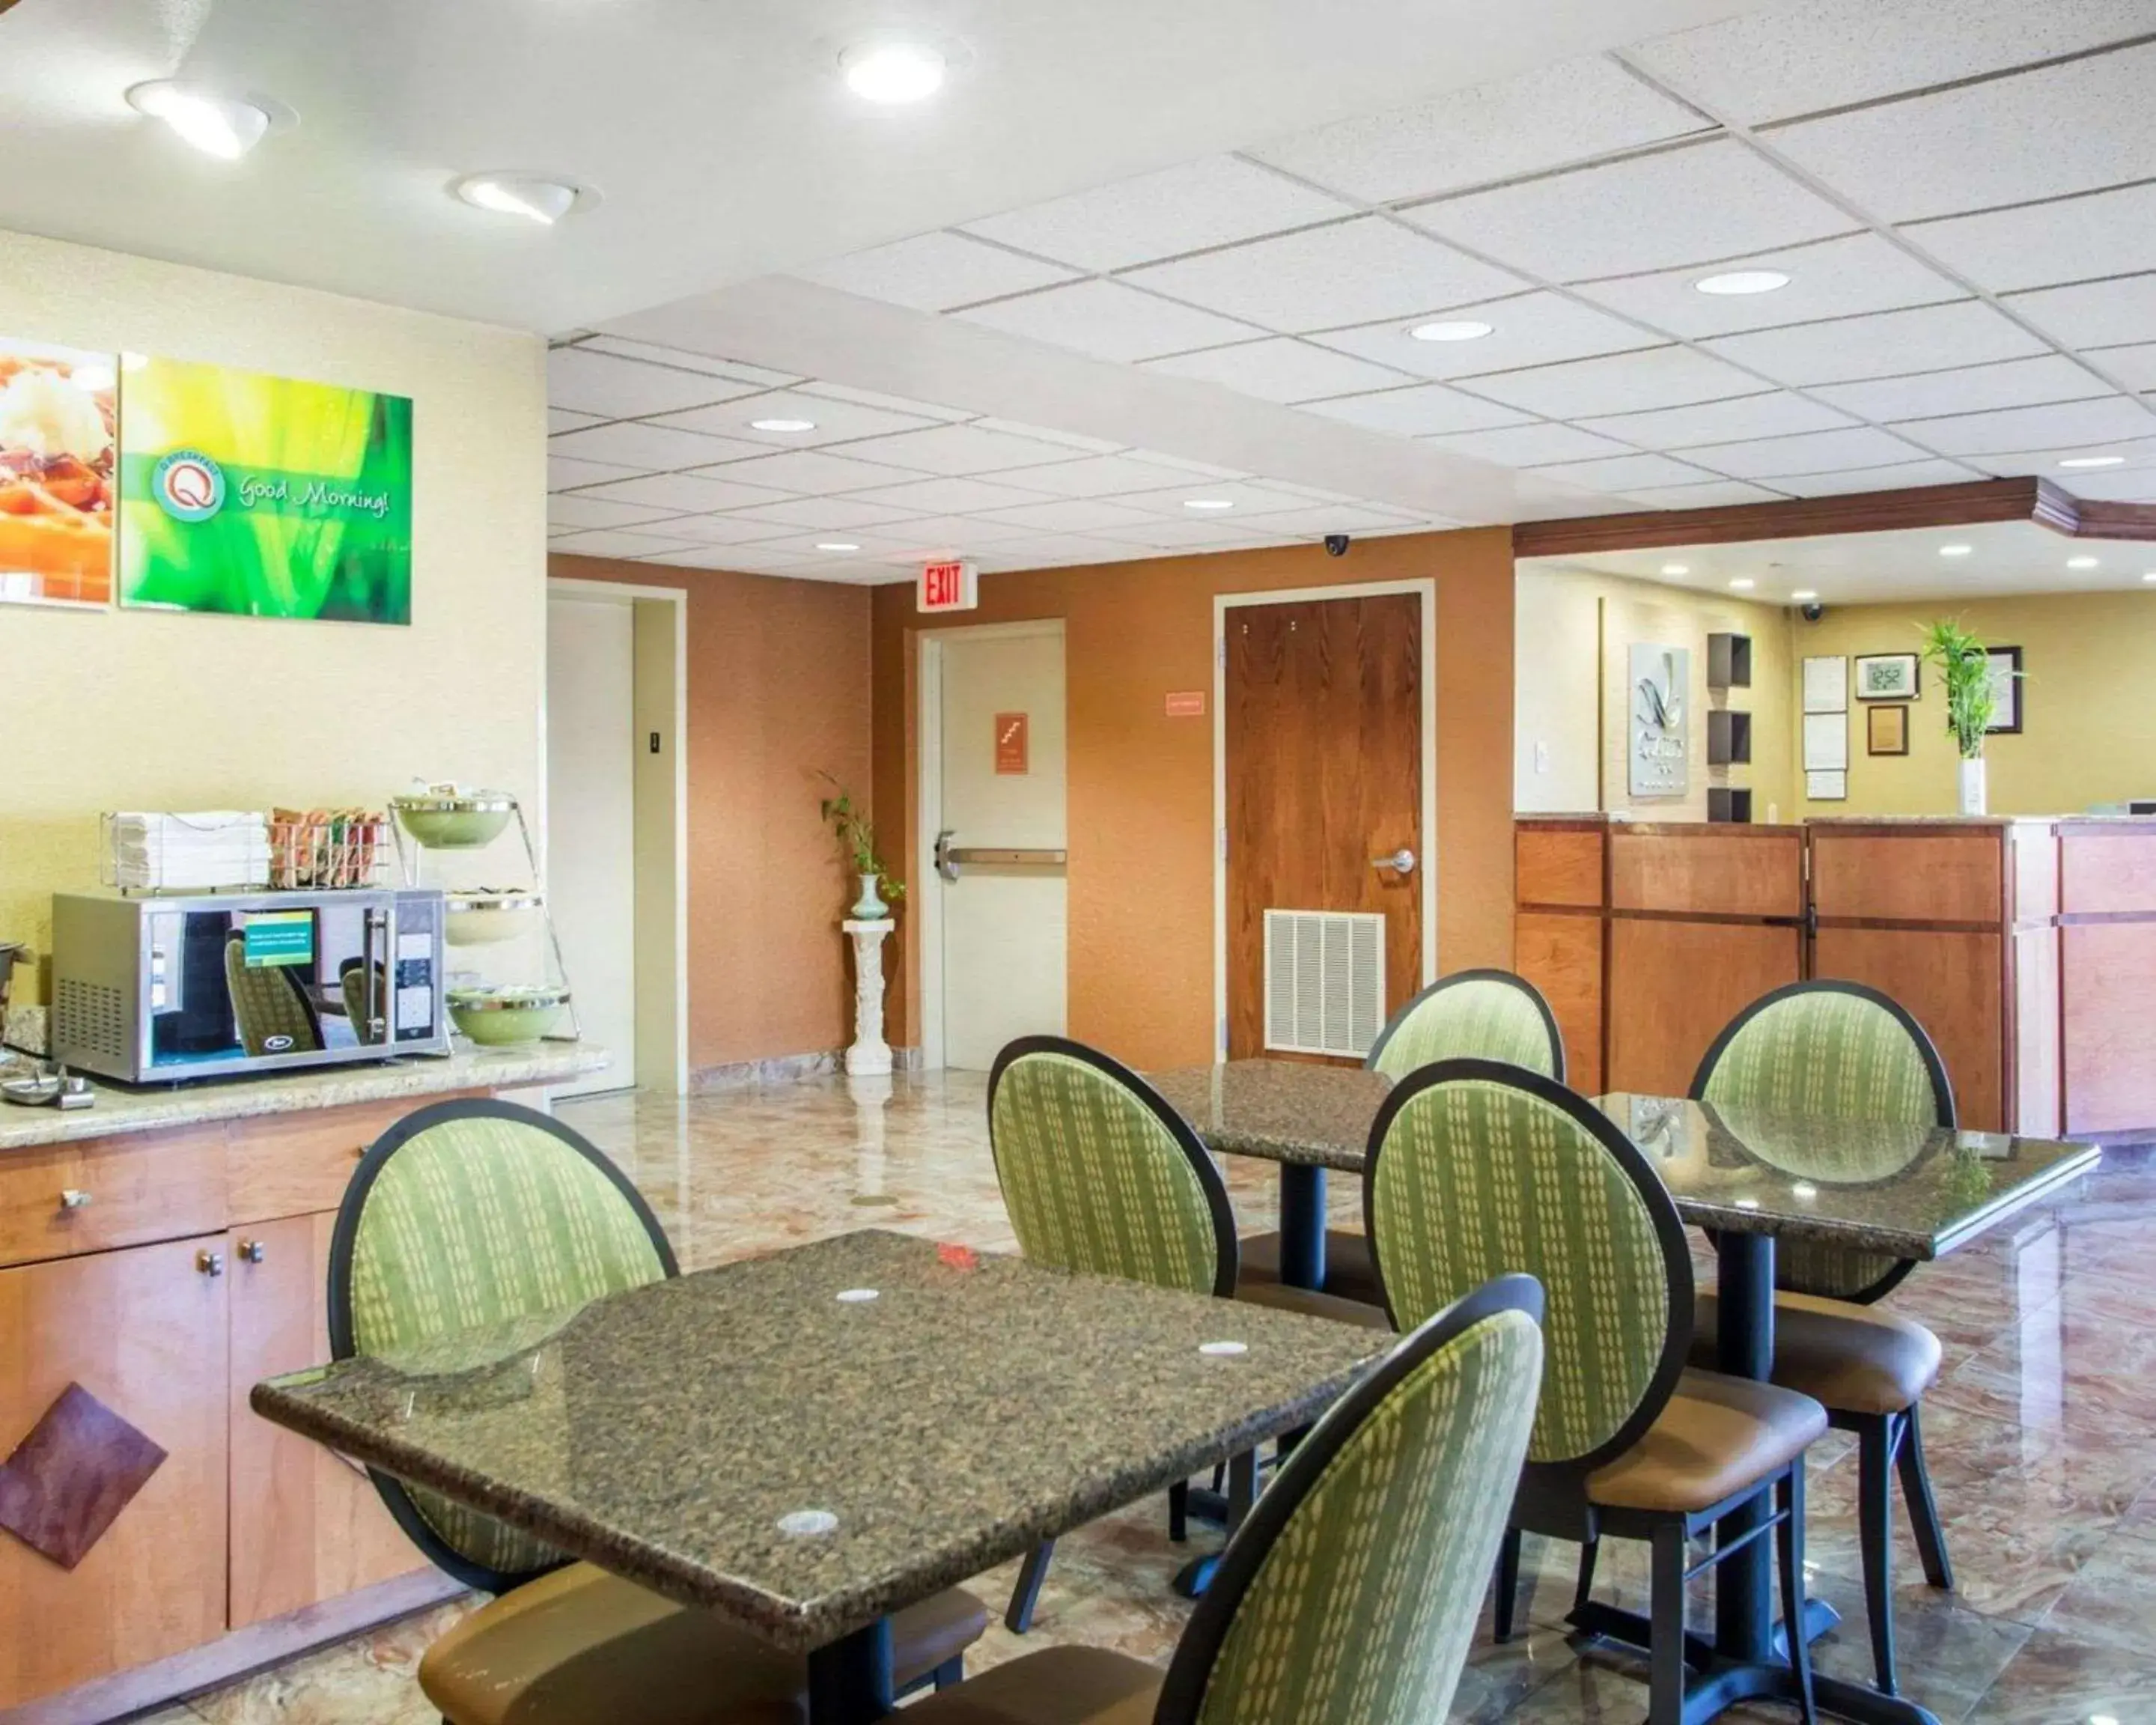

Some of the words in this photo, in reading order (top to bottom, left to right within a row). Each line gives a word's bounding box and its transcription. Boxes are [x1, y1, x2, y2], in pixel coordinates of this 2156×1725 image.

[168, 464, 216, 508] Q
[239, 474, 288, 508] Good
[291, 481, 390, 519] Morning!
[926, 565, 960, 606] EXIT
